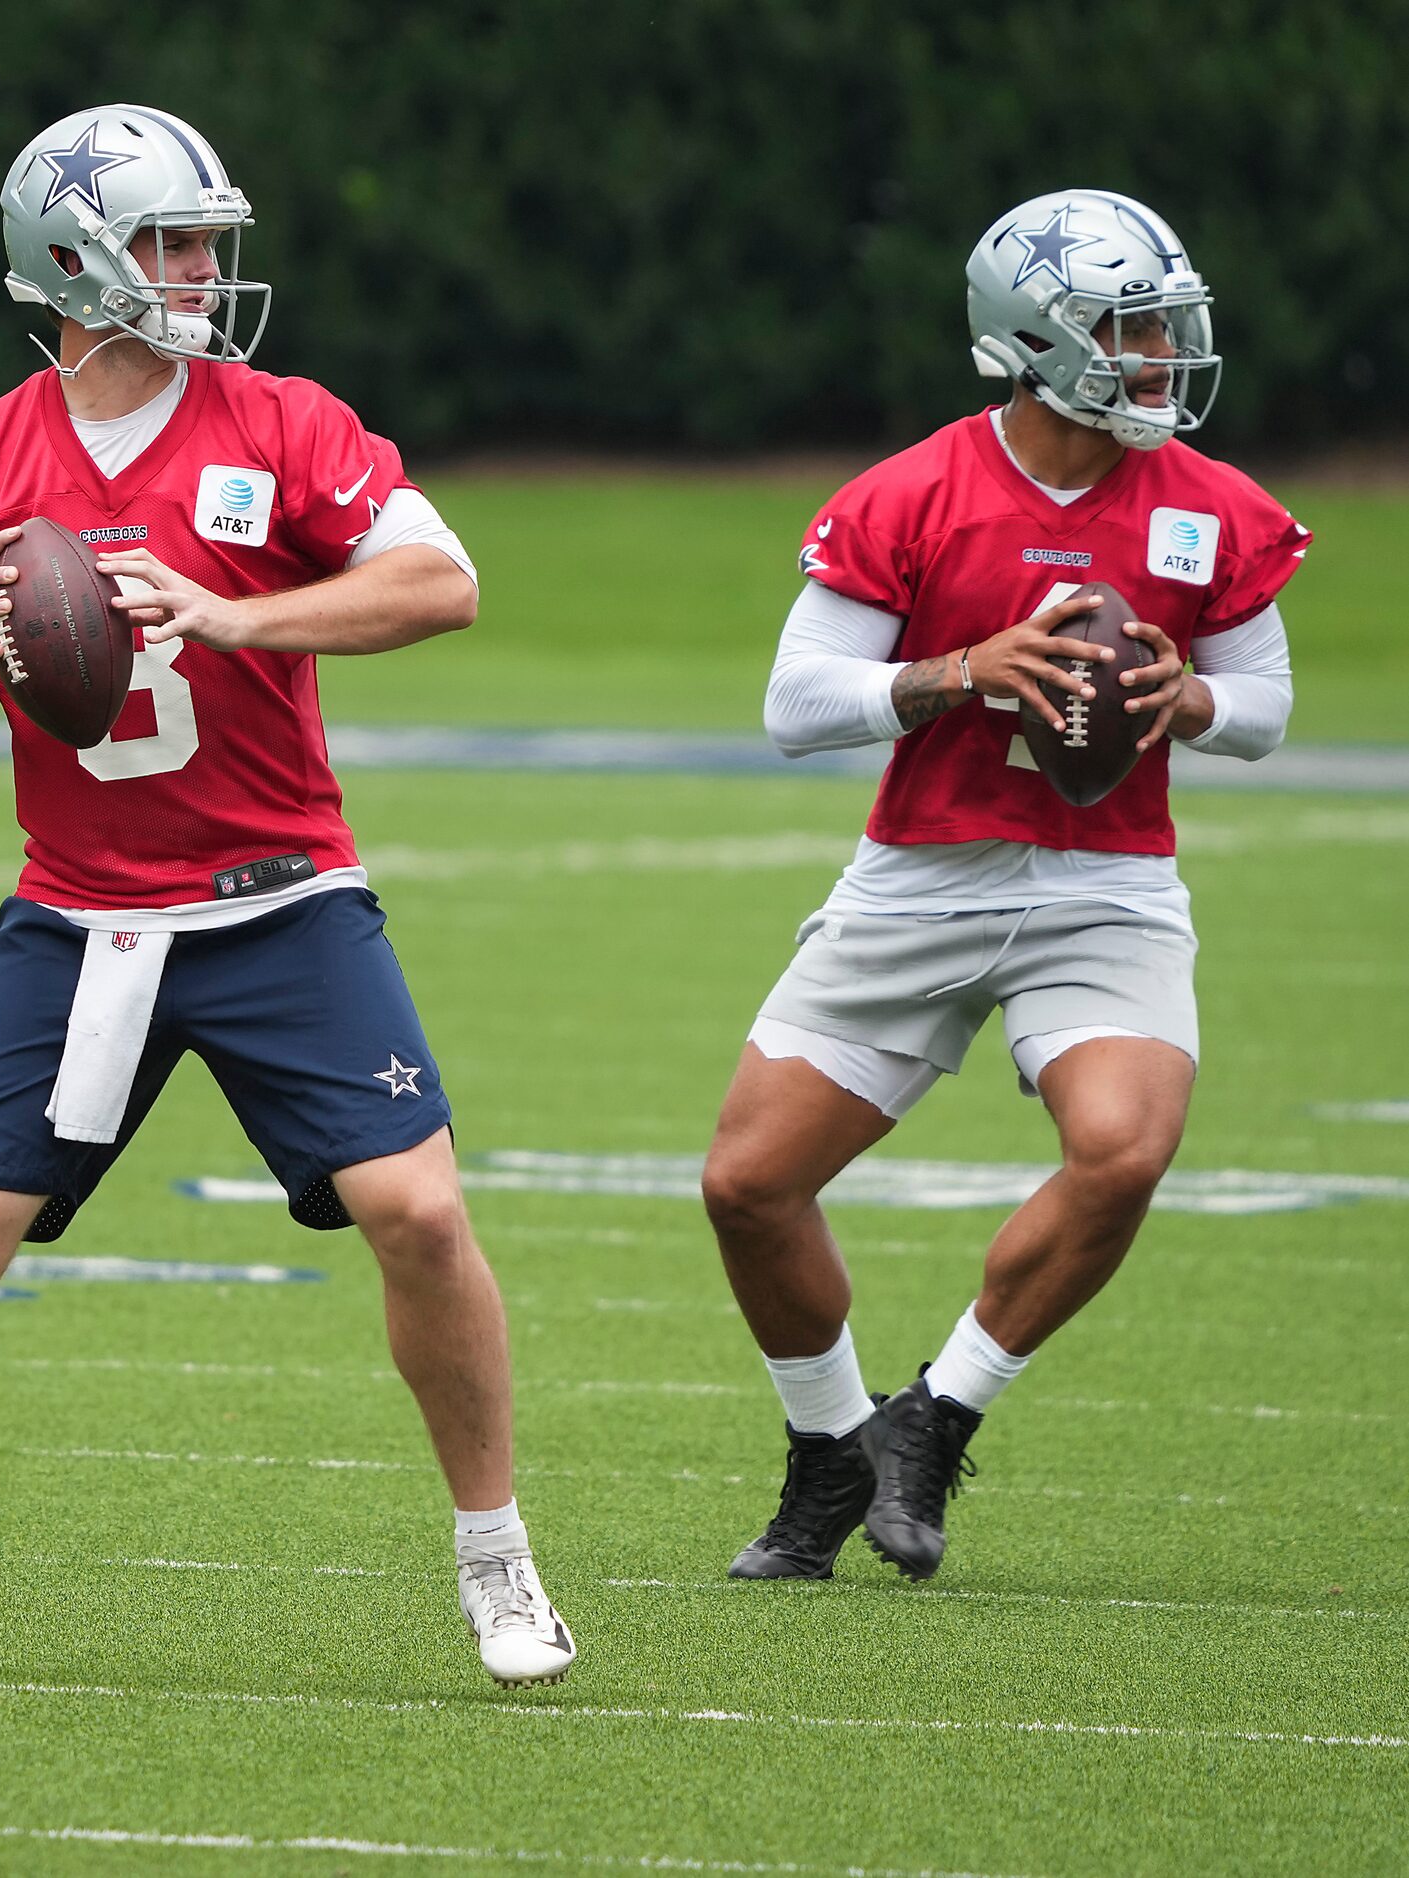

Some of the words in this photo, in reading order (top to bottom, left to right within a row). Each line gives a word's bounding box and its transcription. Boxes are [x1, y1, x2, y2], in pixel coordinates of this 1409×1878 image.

[79, 525, 148, 543] COWBOYS
[210, 515, 254, 535] AT&T
[1022, 548, 1092, 568] COWBOYS
[1163, 555, 1200, 574] AT&T
[60, 591, 80, 641] FOOTBALL
[74, 643, 92, 690] NATIONAL
[260, 860, 282, 875] 50
[113, 931, 138, 948] NFL
